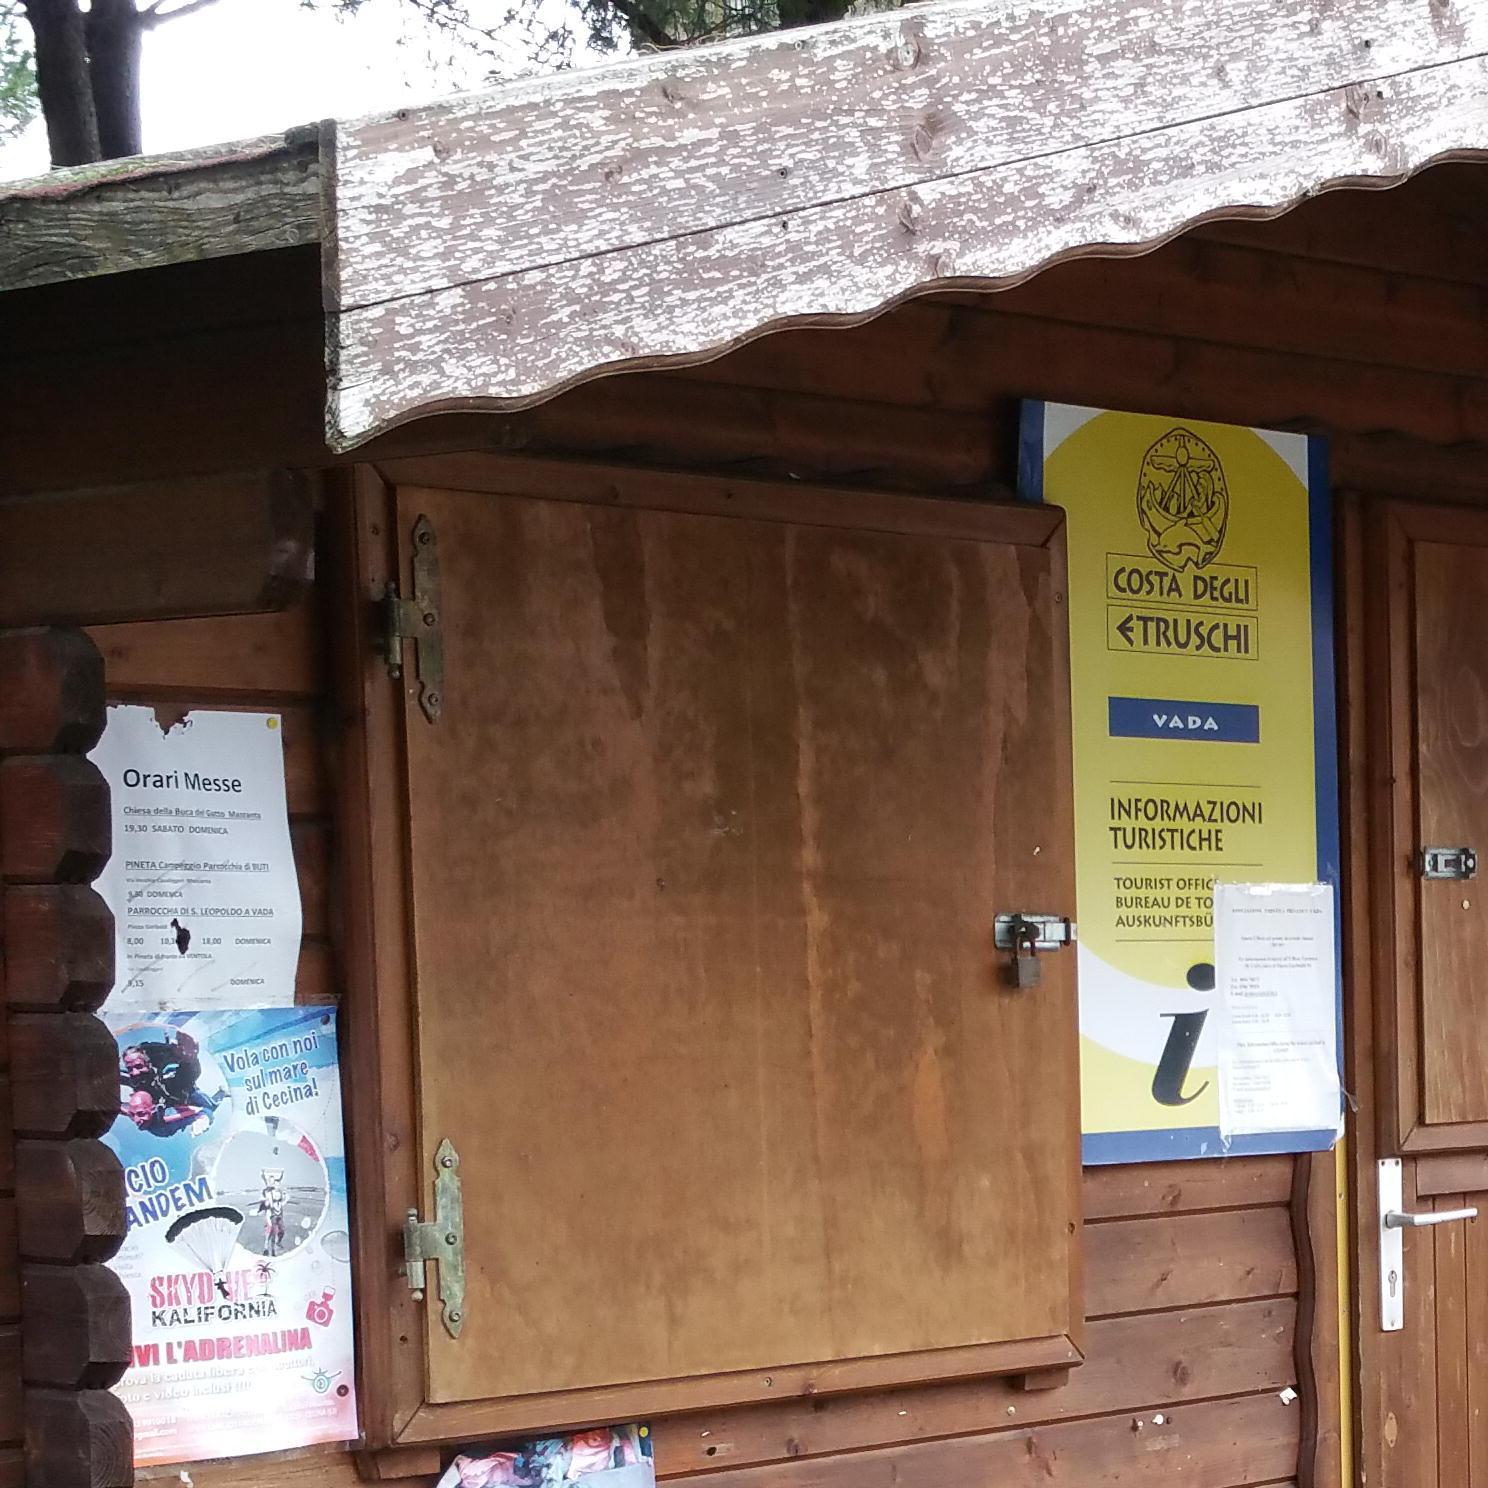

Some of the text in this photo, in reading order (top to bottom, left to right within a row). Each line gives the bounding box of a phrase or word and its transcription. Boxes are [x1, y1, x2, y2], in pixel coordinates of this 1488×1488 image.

[1113, 566, 1250, 605] COSTA DEGLI
[1116, 613, 1250, 654] ETRUSCHI
[1152, 714, 1218, 731] VADA
[123, 768, 242, 793] Orari Messe
[1109, 797, 1264, 826] INFORMAZIONI
[124, 823, 229, 835] 19,30 SABATO DOMENICA
[1109, 825, 1224, 853] TURISTICHE
[125, 860, 157, 870] PINETA
[1114, 877, 1216, 891] TOURIST OFFIC
[128, 907, 179, 916] PARROCCHIA
[200, 908, 243, 916] LEOPOLDO
[251, 908, 274, 916] VADA
[1116, 896, 1171, 909] BUREAU
[1175, 896, 1192, 909] DE
[1115, 912, 1214, 928] AUSKUNFTSBÜ
[223, 1031, 318, 1073] Vola con noi
[245, 1062, 309, 1092] sul mare
[245, 1077, 319, 1116] di Cecina!
[126, 1177, 213, 1233] ANDEM
[151, 1299, 278, 1328] KALIFORNIA
[166, 1327, 313, 1365] L'ADRENALINA
